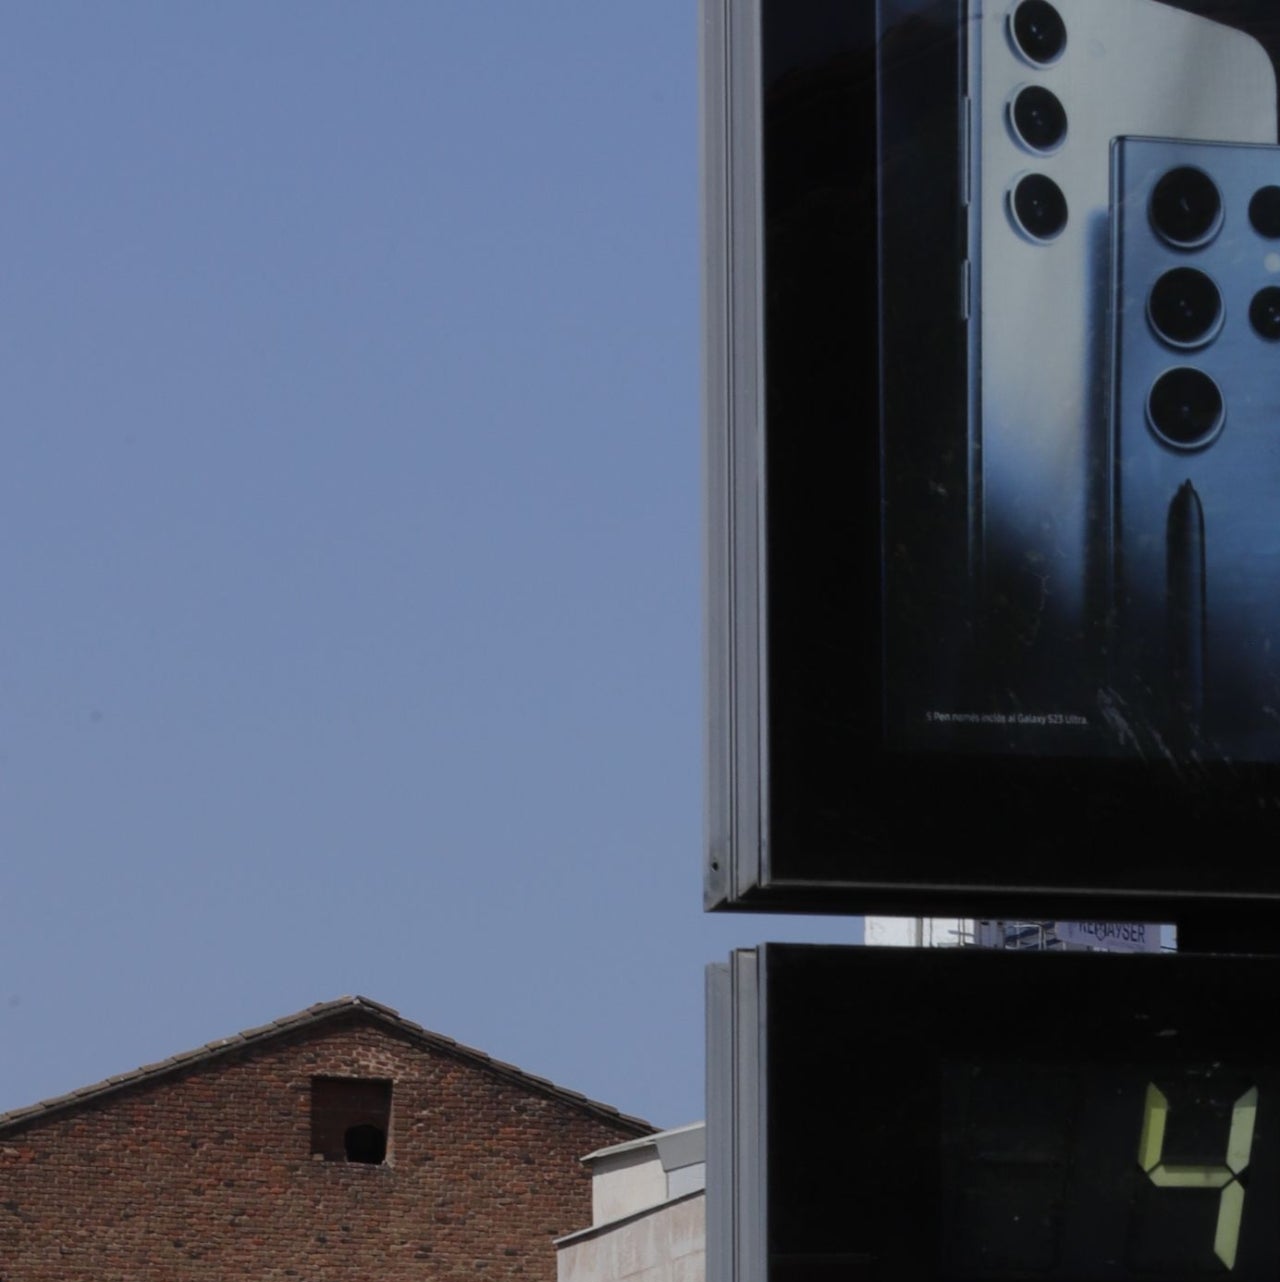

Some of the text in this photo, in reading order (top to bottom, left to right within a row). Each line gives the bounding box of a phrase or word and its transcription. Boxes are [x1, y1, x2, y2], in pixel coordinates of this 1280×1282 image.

[933, 711, 950, 722] Pen
[1018, 712, 1046, 725] Galaxy
[1047, 713, 1064, 724] S23
